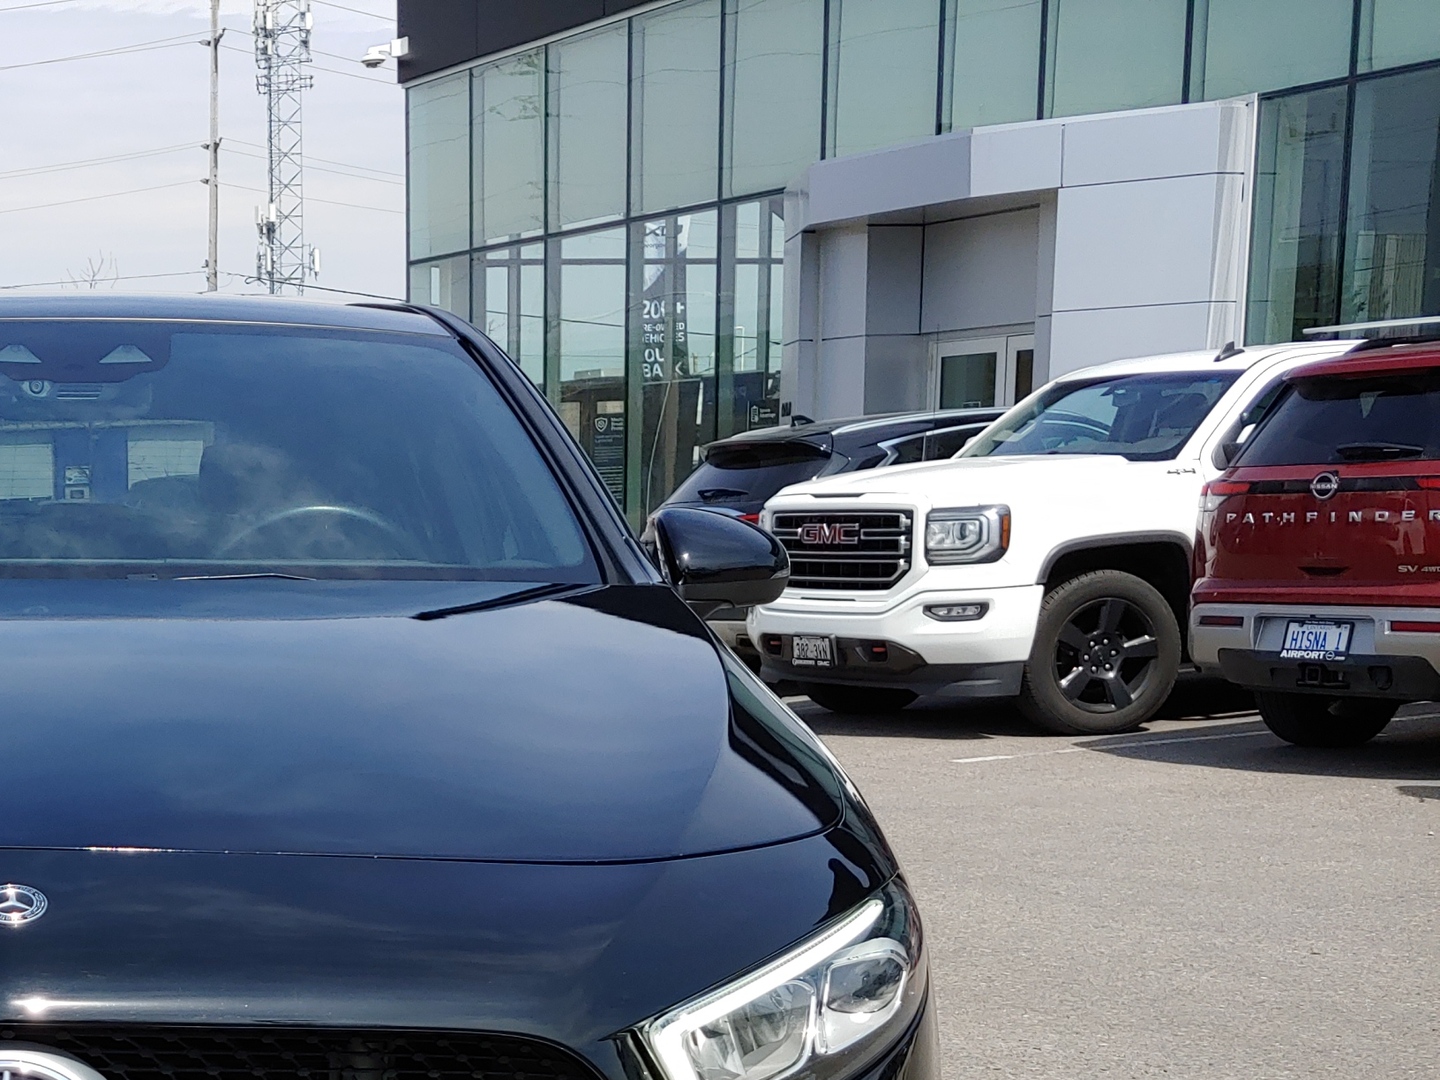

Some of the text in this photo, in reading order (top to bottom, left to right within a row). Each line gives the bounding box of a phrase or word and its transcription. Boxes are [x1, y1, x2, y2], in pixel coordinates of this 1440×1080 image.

[1226, 510, 1440, 524] PATHFINDER
[801, 523, 860, 545] GMC
[1398, 565, 1419, 573] SV
[1290, 631, 1328, 650] HISNA
[1280, 649, 1326, 660] AIRPORT
